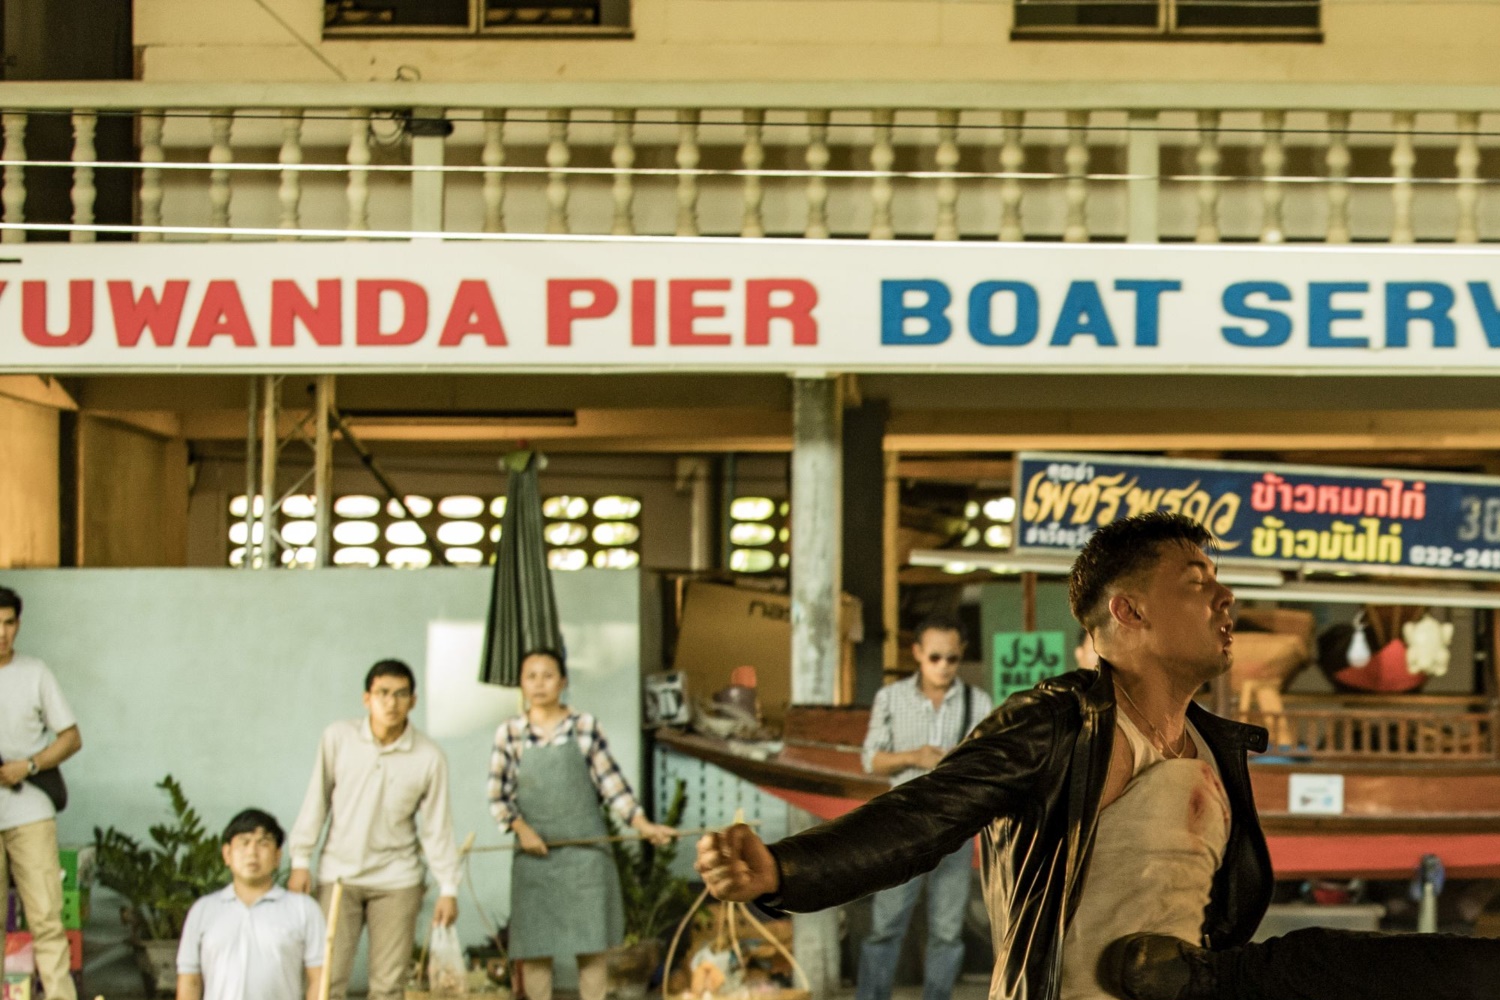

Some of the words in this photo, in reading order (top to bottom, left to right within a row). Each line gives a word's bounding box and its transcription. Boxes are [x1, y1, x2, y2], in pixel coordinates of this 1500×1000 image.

[0, 278, 507, 348] UWANDA
[546, 278, 820, 347] PIER
[880, 279, 1181, 347] BOAT
[1251, 471, 1426, 520] ข้าวหมกไก่
[1251, 515, 1402, 563] ข้าวมันไก่
